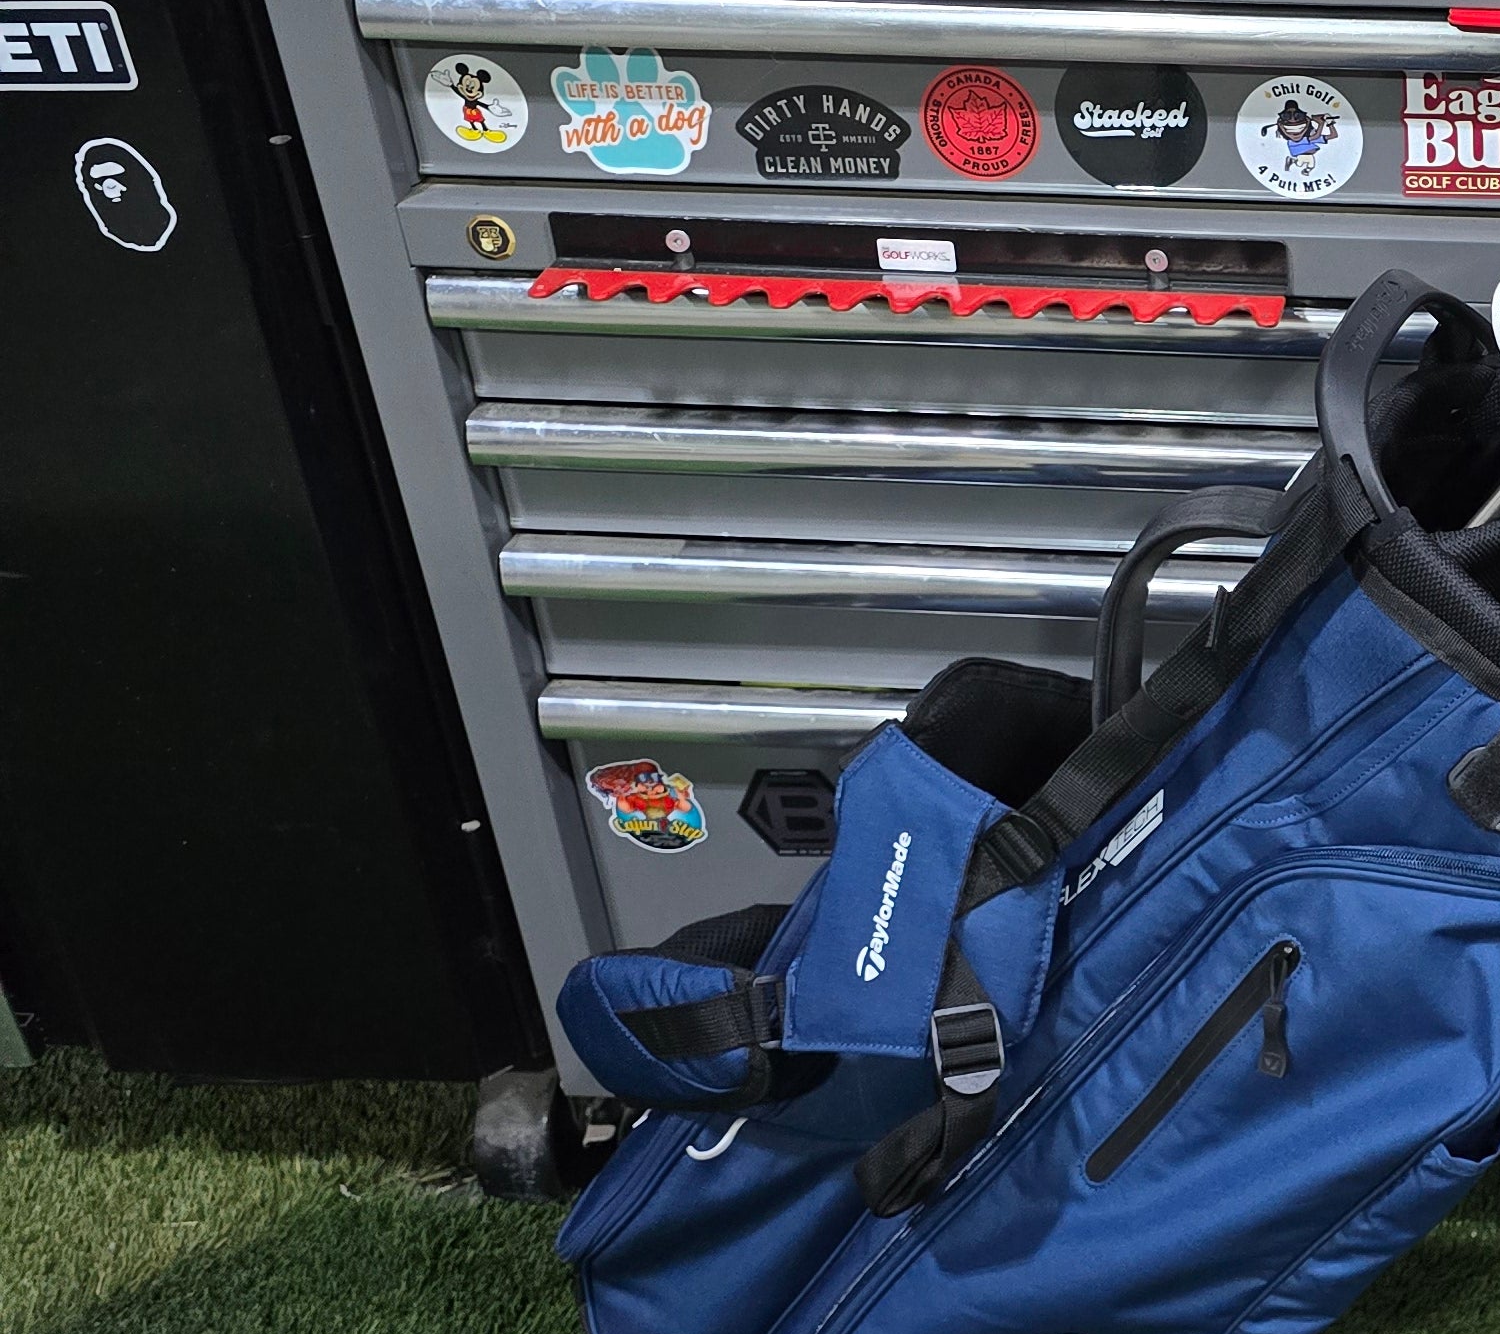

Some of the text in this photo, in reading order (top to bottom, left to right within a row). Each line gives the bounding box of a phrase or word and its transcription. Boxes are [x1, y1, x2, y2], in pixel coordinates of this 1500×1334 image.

[0, 22, 114, 73] ETI
[567, 83, 685, 101] LIFE IS BETTER
[946, 74, 1001, 89] CANADA
[1271, 82, 1336, 106] Chit Golf
[565, 103, 706, 148] with a dog
[744, 93, 901, 142] DIRTY HANDS
[932, 98, 948, 148] STRONG
[1073, 100, 1190, 130] Stacked
[969, 145, 1000, 156] 1867
[764, 156, 891, 174] CLEAN MONEY
[962, 157, 1010, 172] PROUD
[1258, 164, 1337, 194] 4 Putt MFs!
[1405, 176, 1451, 189] GOLF
[1455, 177, 1500, 190] CLUB
[881, 249, 951, 262] GOLFWORKS
[614, 817, 658, 838] Cajun
[856, 832, 912, 982] TaylorMade
